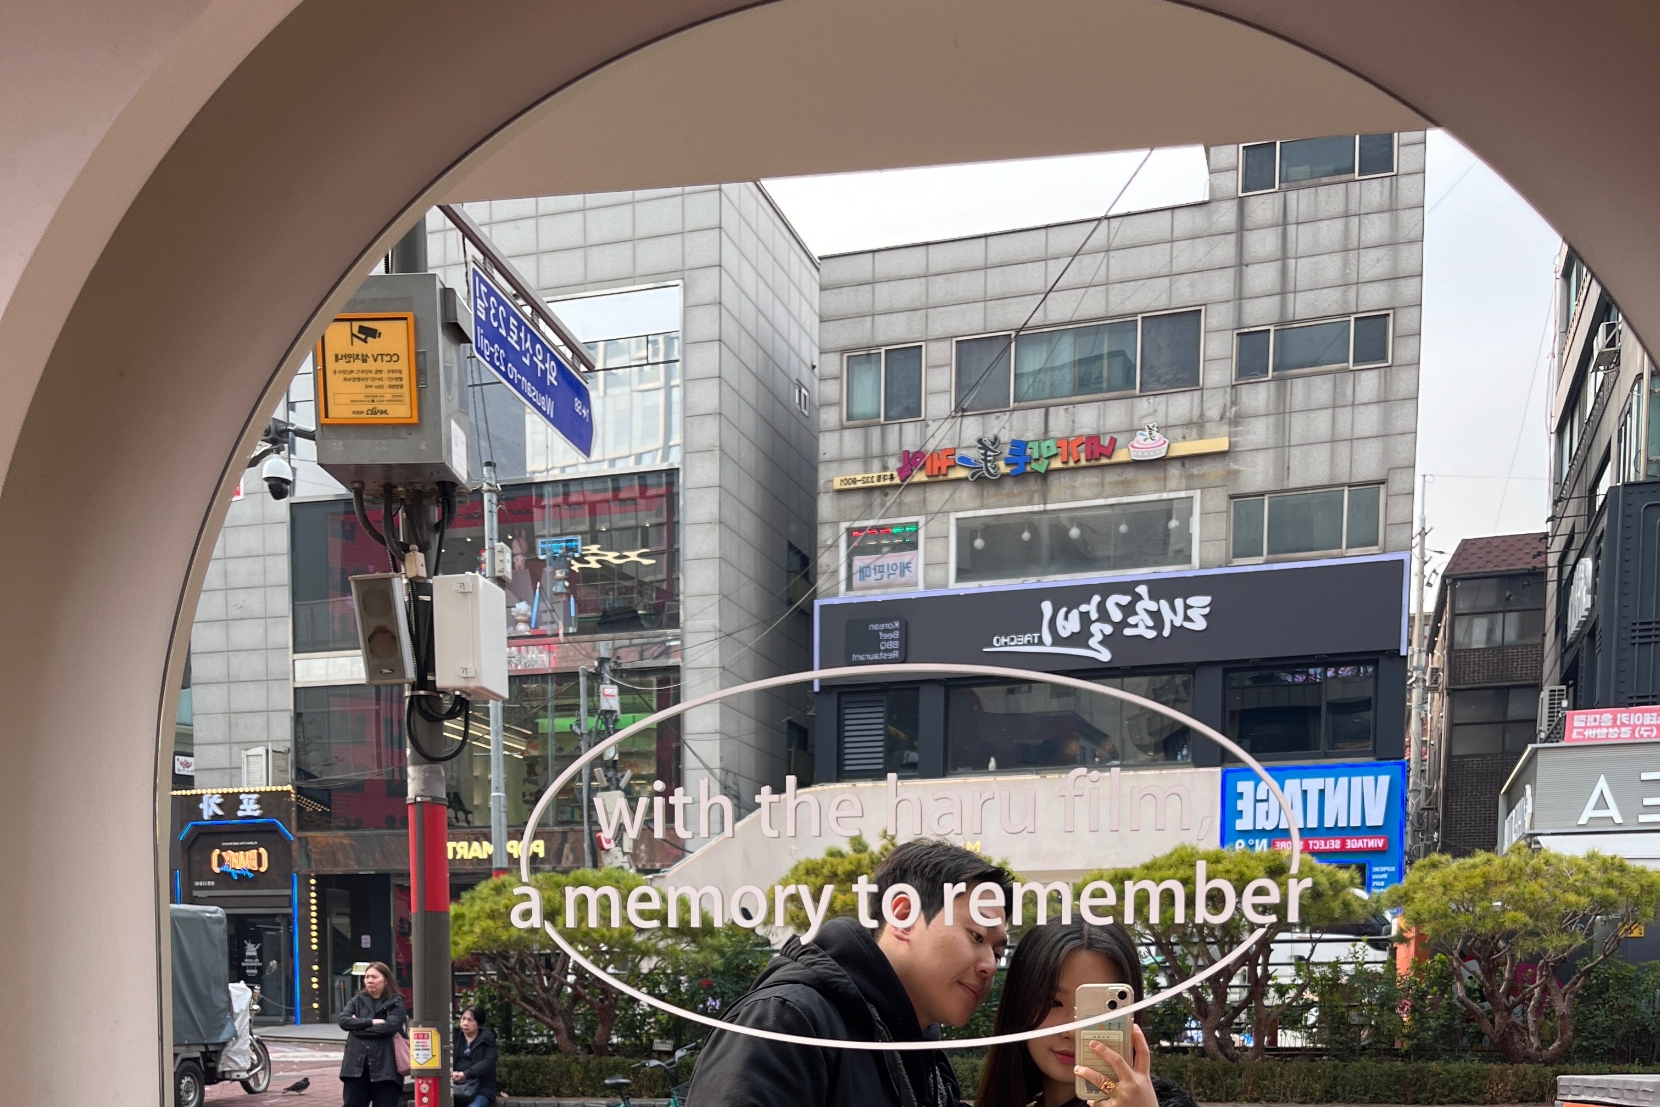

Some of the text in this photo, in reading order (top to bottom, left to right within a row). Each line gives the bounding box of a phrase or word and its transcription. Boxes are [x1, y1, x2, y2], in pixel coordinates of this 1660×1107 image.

[593, 767, 1213, 841] with the haru film,
[509, 859, 1313, 946] a memory to remember
